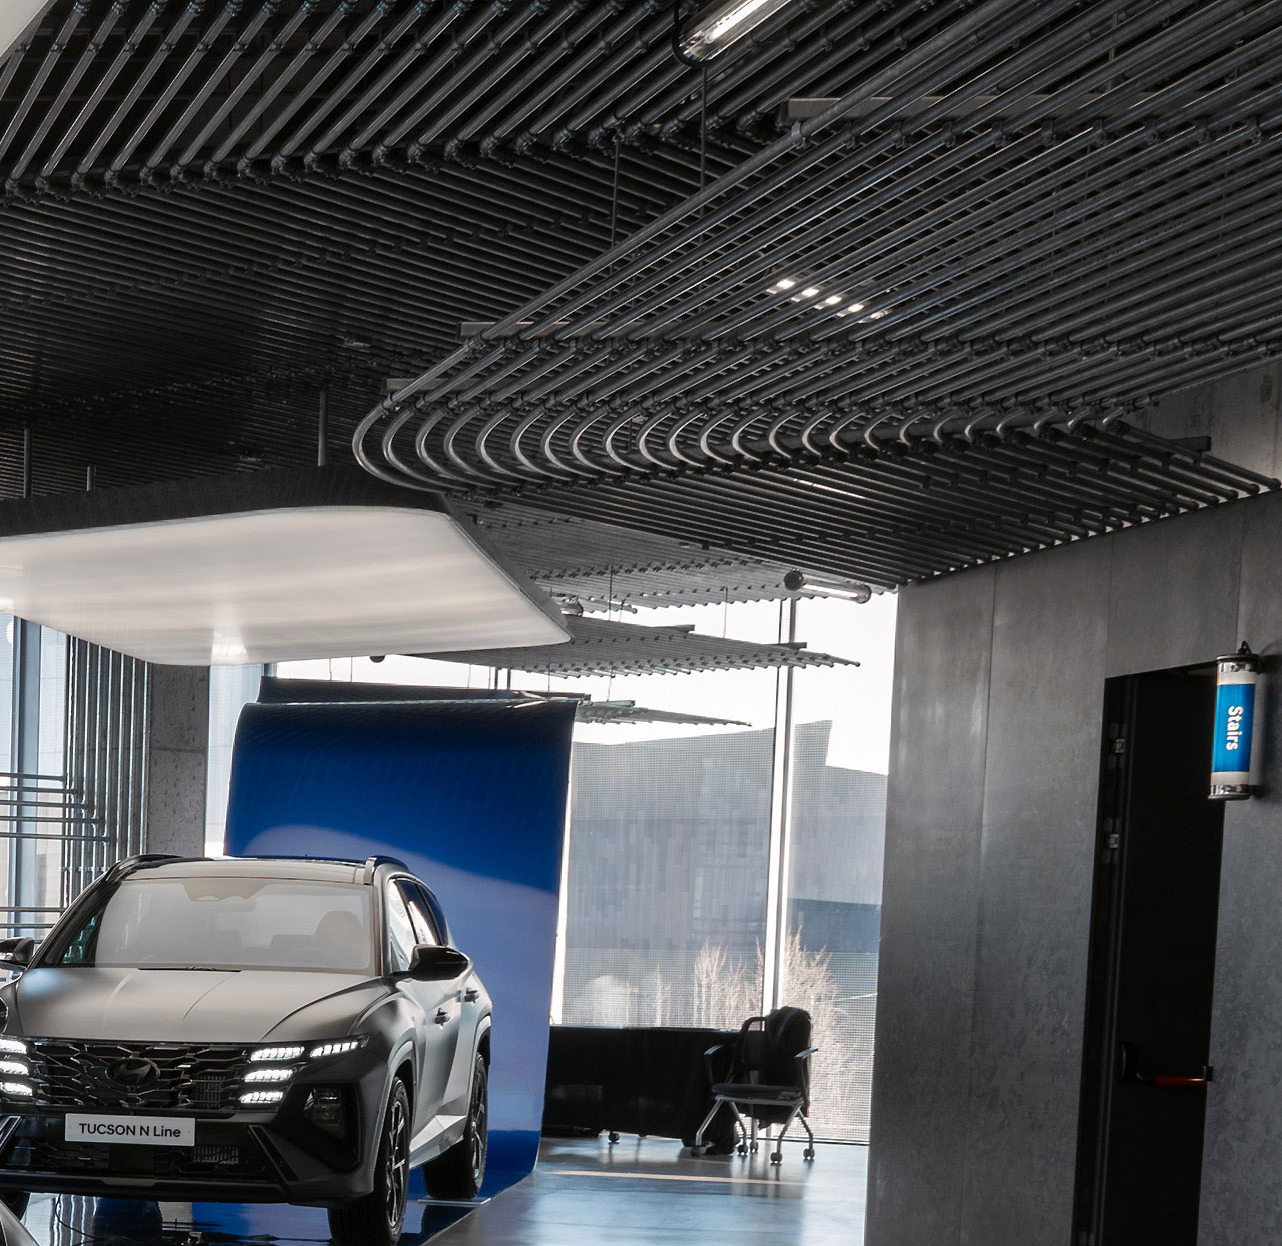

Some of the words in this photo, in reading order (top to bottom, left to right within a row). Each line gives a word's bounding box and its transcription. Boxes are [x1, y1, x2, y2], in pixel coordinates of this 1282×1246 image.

[1226, 705, 1244, 751] Stairs
[79, 1123, 136, 1136] TUCSON
[139, 1125, 150, 1136] N
[153, 1125, 181, 1138] Line
